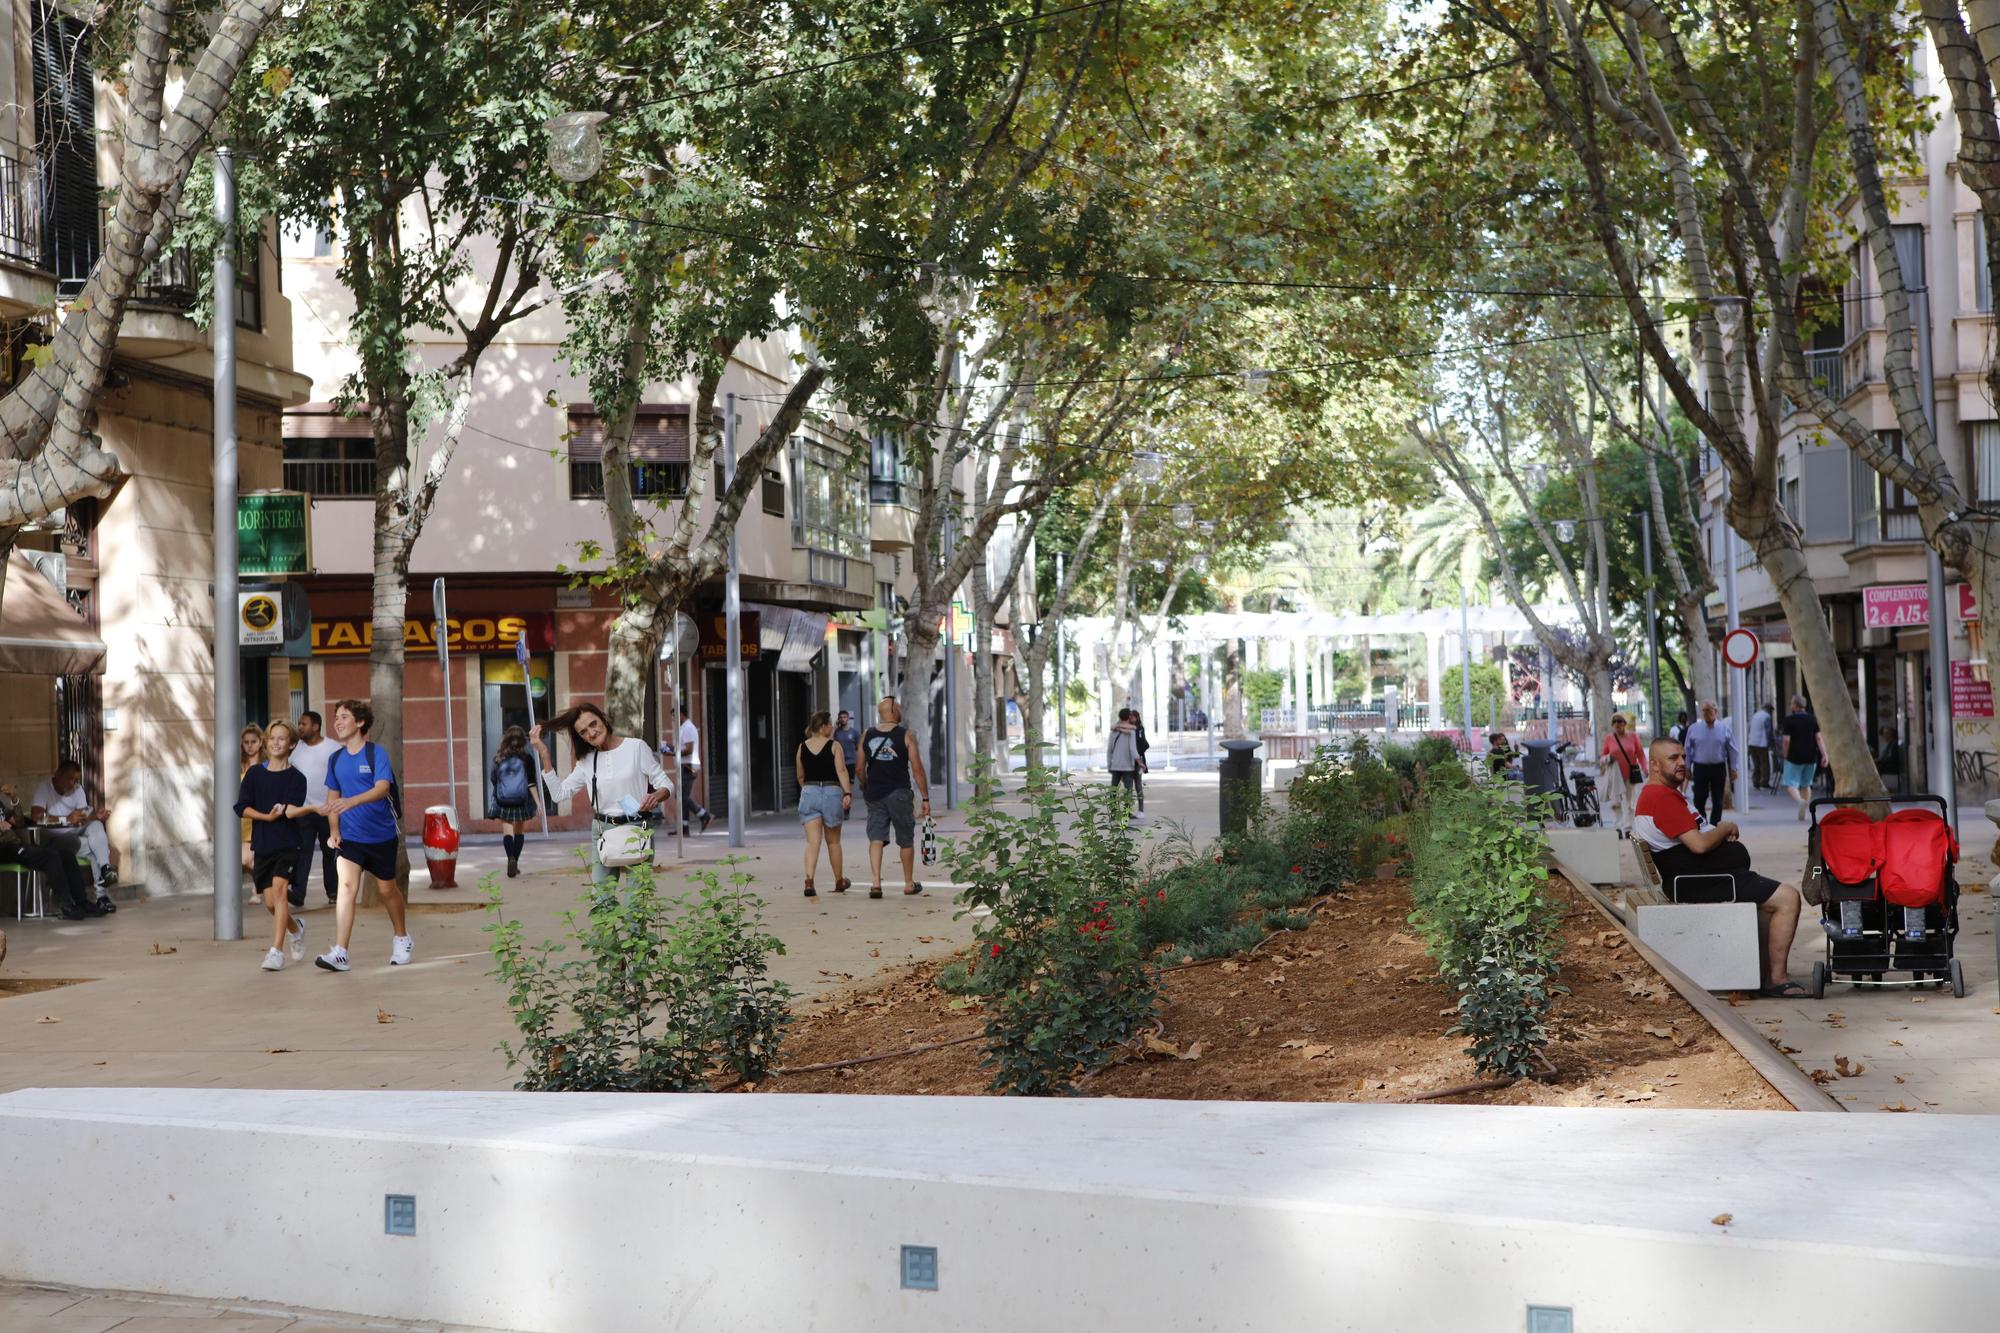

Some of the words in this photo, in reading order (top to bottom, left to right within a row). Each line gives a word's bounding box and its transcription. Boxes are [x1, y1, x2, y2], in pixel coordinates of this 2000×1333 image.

[238, 509, 303, 530] LORISTERIA
[1869, 588, 1928, 603] COMPLEMENTOS
[311, 617, 527, 647] TAACOS
[702, 643, 758, 656] TABOS
